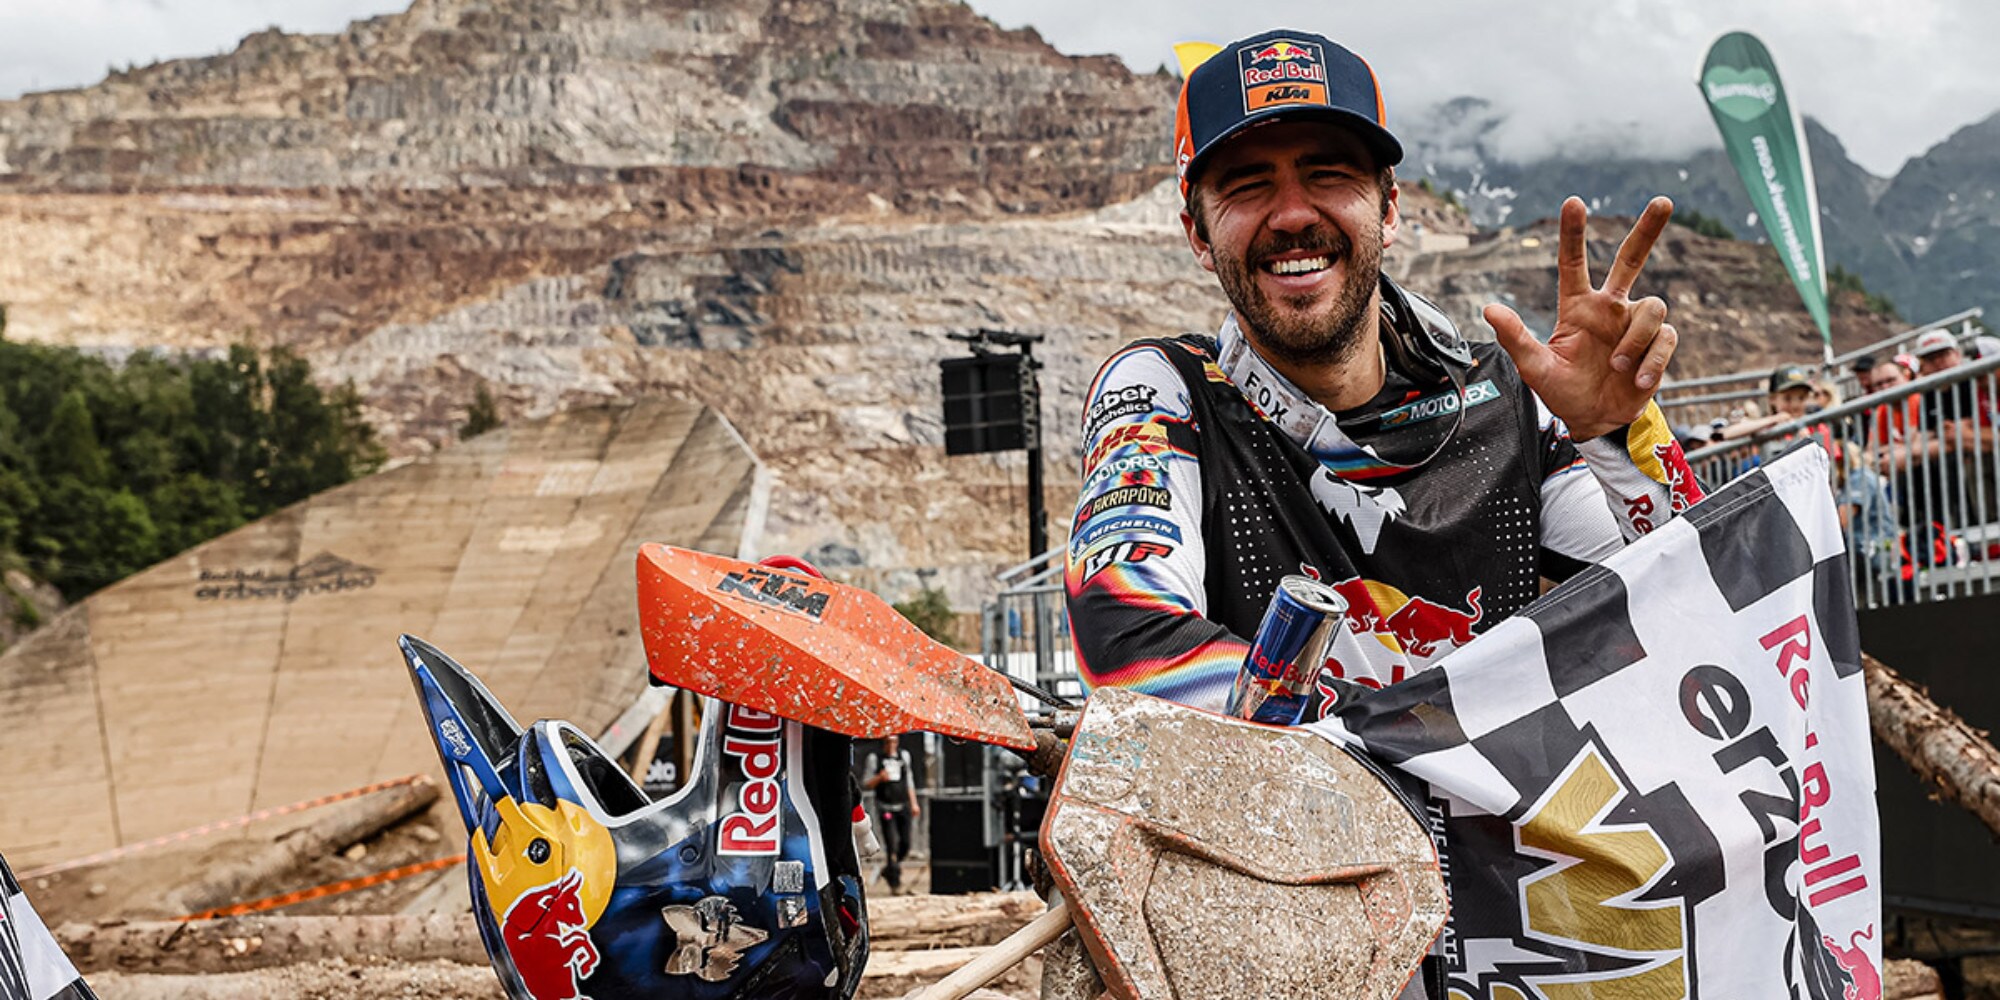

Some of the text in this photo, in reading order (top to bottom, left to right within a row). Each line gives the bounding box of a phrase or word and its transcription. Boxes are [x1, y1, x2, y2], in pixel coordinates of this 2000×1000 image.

[1245, 62, 1323, 86] Red Bull
[1265, 85, 1310, 102] KTM
[1244, 371, 1289, 424] FOX
[1087, 424, 1151, 477] DHL
[1089, 520, 1173, 539] MICHELIN
[1622, 493, 1655, 534] Re
[716, 568, 830, 618] KTM
[1252, 643, 1285, 677] Red
[1284, 662, 1323, 687] Bull
[1758, 614, 1869, 908] Re Bull
[718, 737, 781, 855] Red
